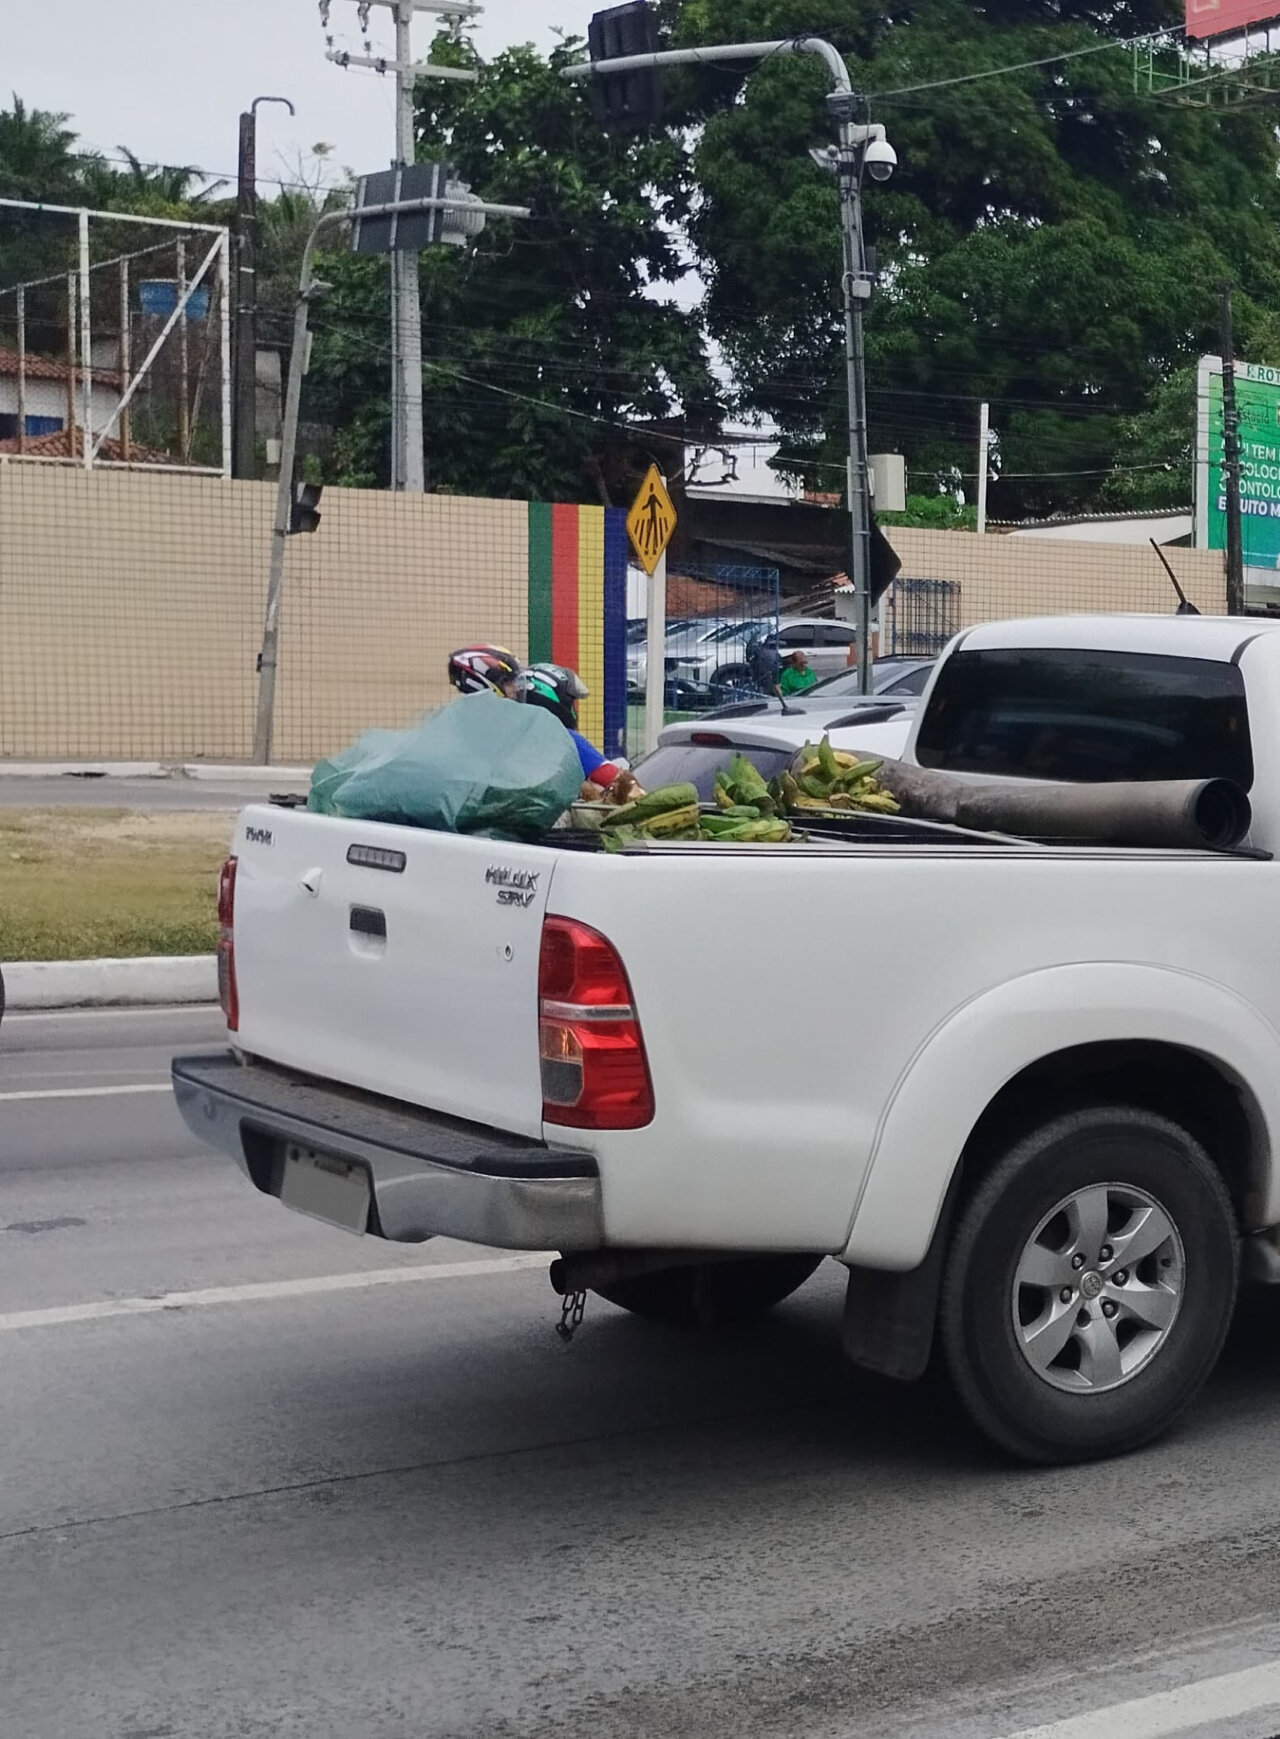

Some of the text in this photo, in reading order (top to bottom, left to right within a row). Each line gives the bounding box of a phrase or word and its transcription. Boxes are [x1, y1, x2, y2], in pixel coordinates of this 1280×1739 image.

[1251, 444, 1276, 461] TEM
[1231, 497, 1268, 516] UITO
[485, 864, 541, 892] HILUX
[496, 890, 536, 908] SRV
